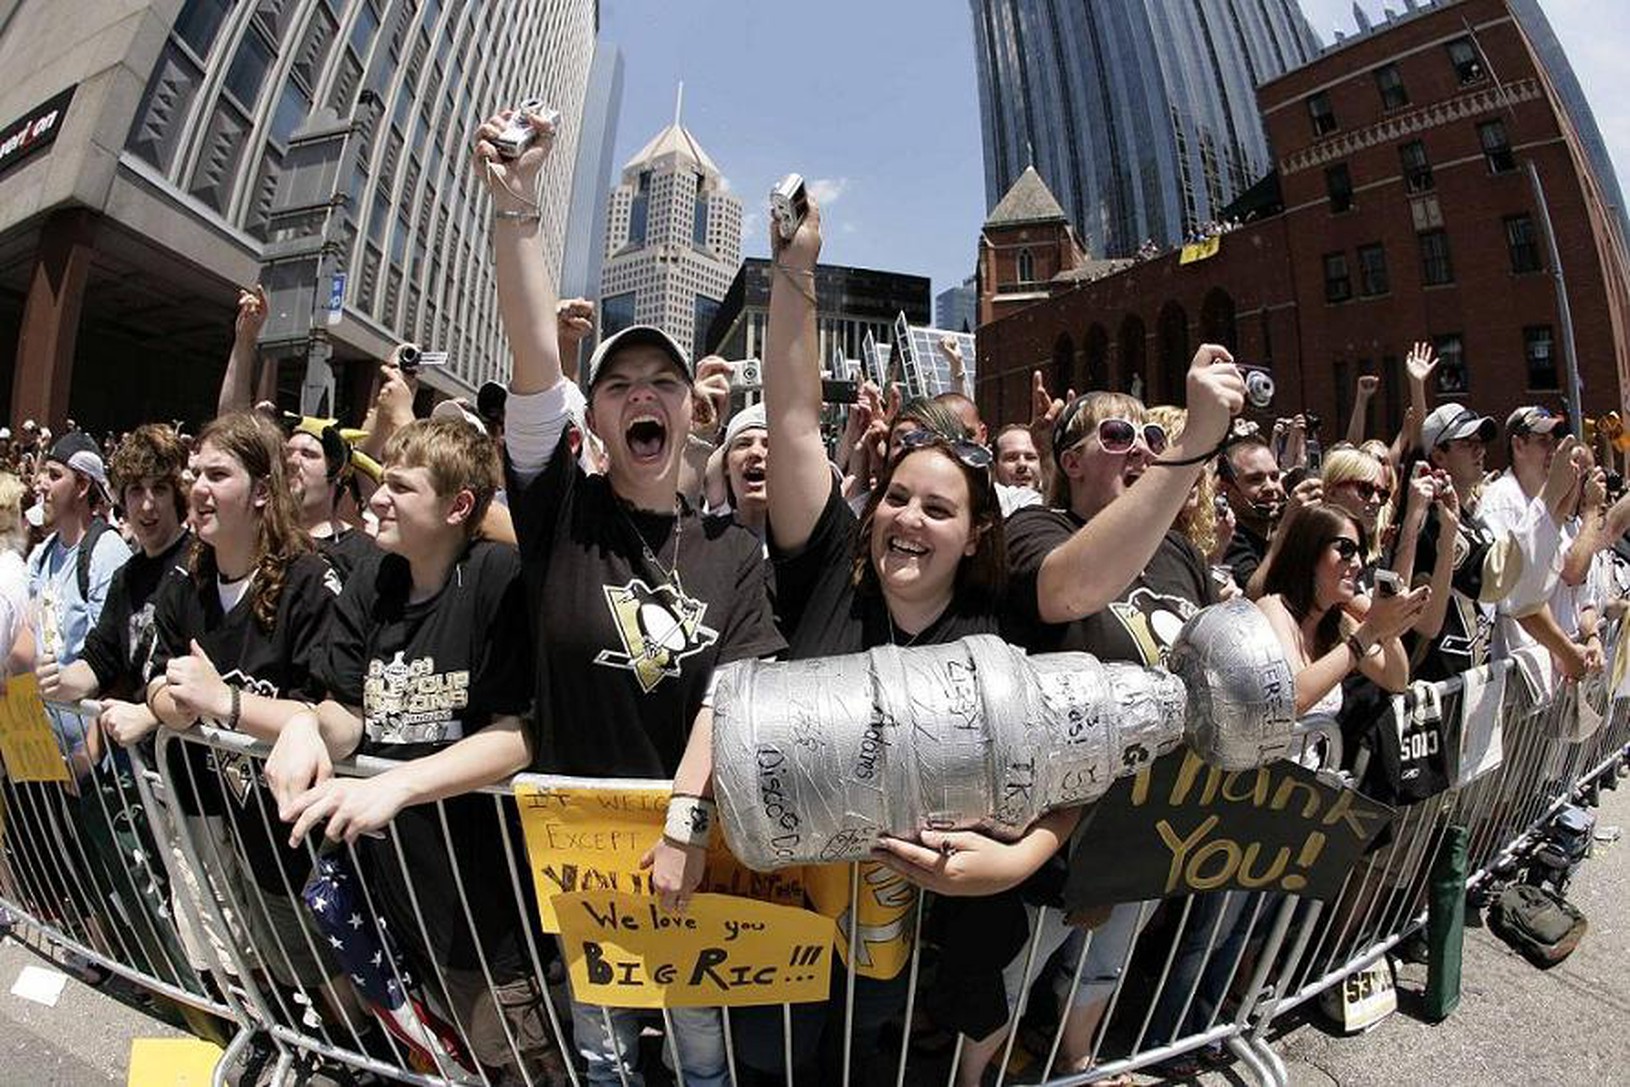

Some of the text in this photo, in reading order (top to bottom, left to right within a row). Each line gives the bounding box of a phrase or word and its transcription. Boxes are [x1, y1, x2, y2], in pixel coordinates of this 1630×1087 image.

[545, 823, 640, 852] EXCEPT
[582, 900, 766, 942] We love you
